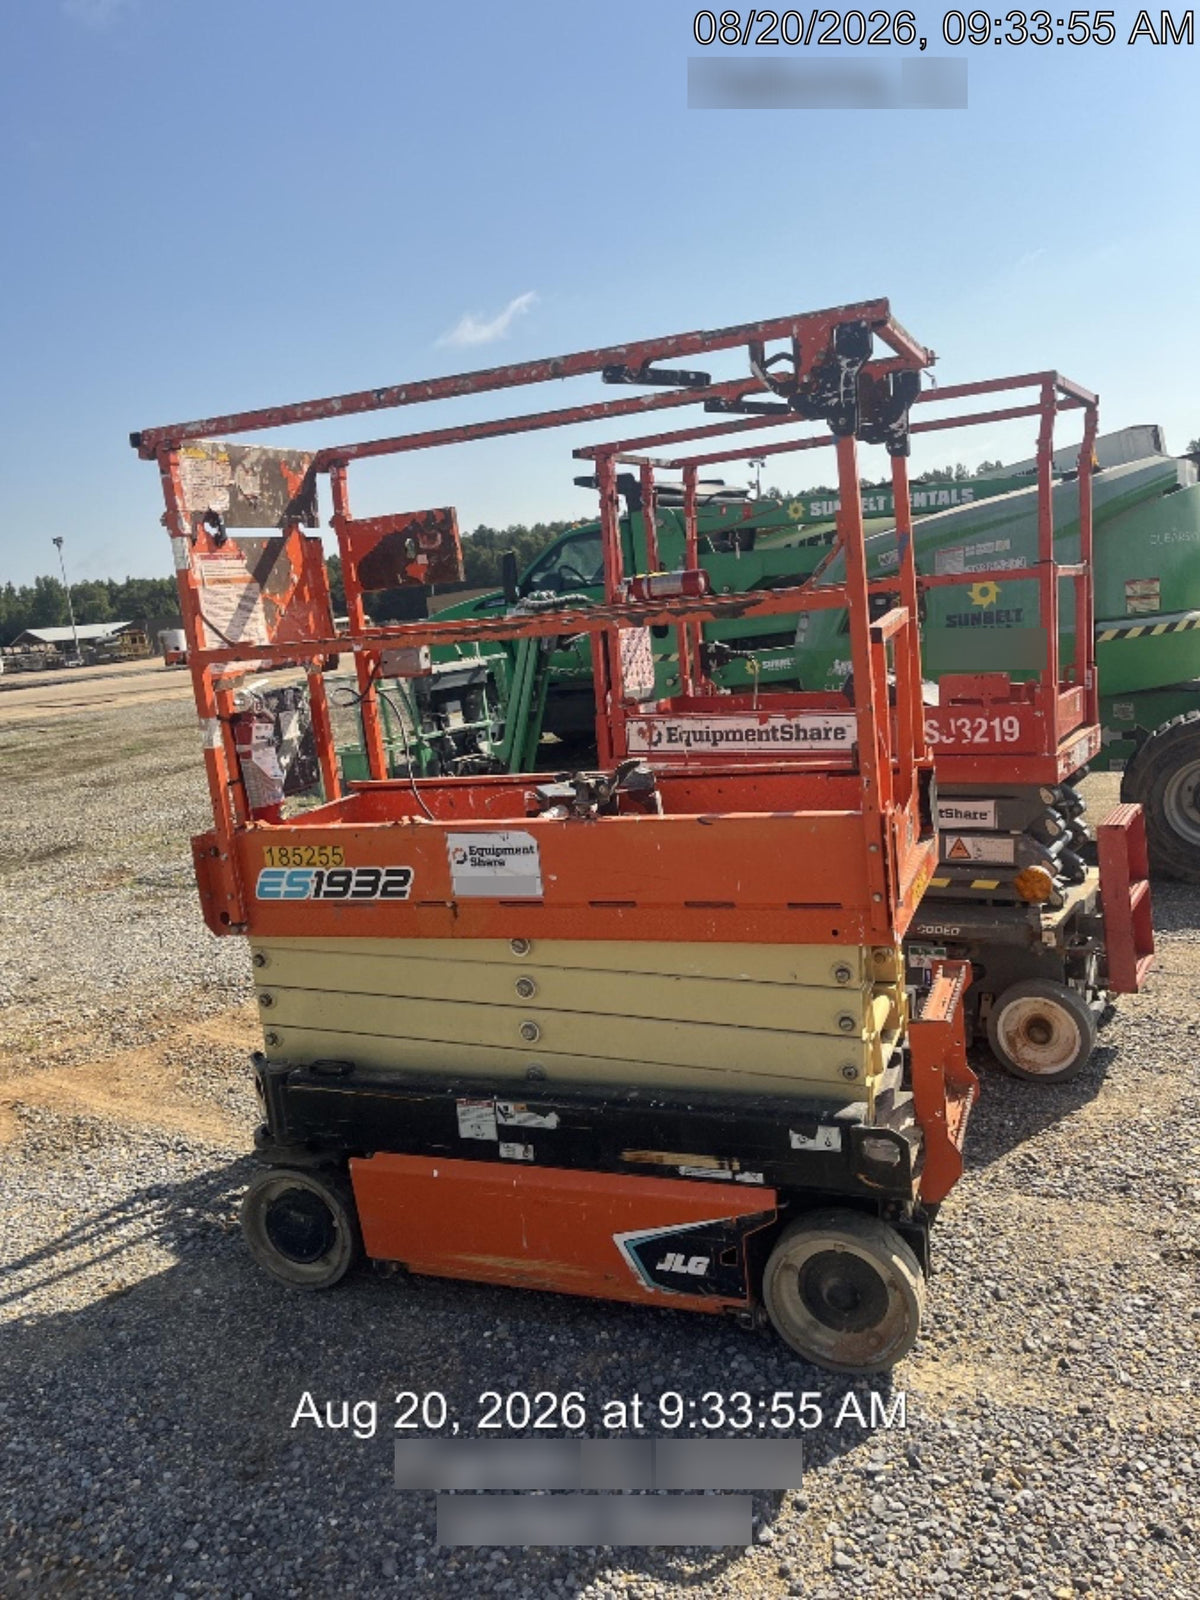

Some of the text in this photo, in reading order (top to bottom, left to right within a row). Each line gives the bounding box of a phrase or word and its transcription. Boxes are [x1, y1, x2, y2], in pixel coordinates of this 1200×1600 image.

[666, 720, 847, 745] EquipmentShare
[265, 846, 344, 866] 185255
[468, 845, 535, 858] Equipment
[470, 857, 505, 867] Share
[256, 869, 412, 900] ES1932
[656, 1252, 709, 1276] JLG
